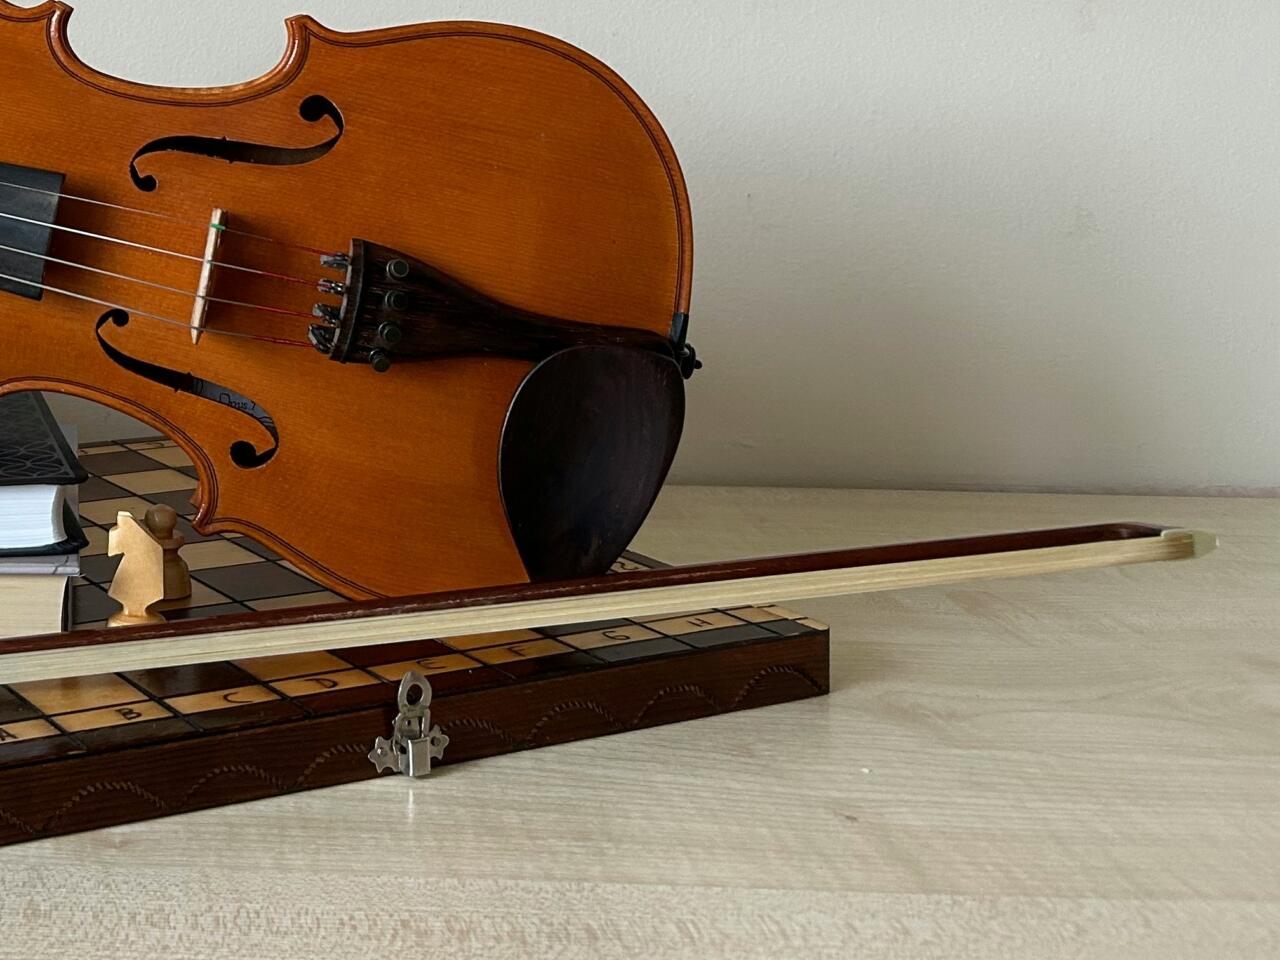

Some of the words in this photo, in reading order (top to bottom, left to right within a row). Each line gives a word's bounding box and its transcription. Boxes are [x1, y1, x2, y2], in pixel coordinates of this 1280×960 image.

[114, 707, 142, 720] B
[223, 692, 254, 704] C
[304, 678, 338, 689] D
[416, 658, 446, 670] E
[507, 645, 528, 656] F
[602, 630, 631, 641] G
[687, 617, 714, 628] H
